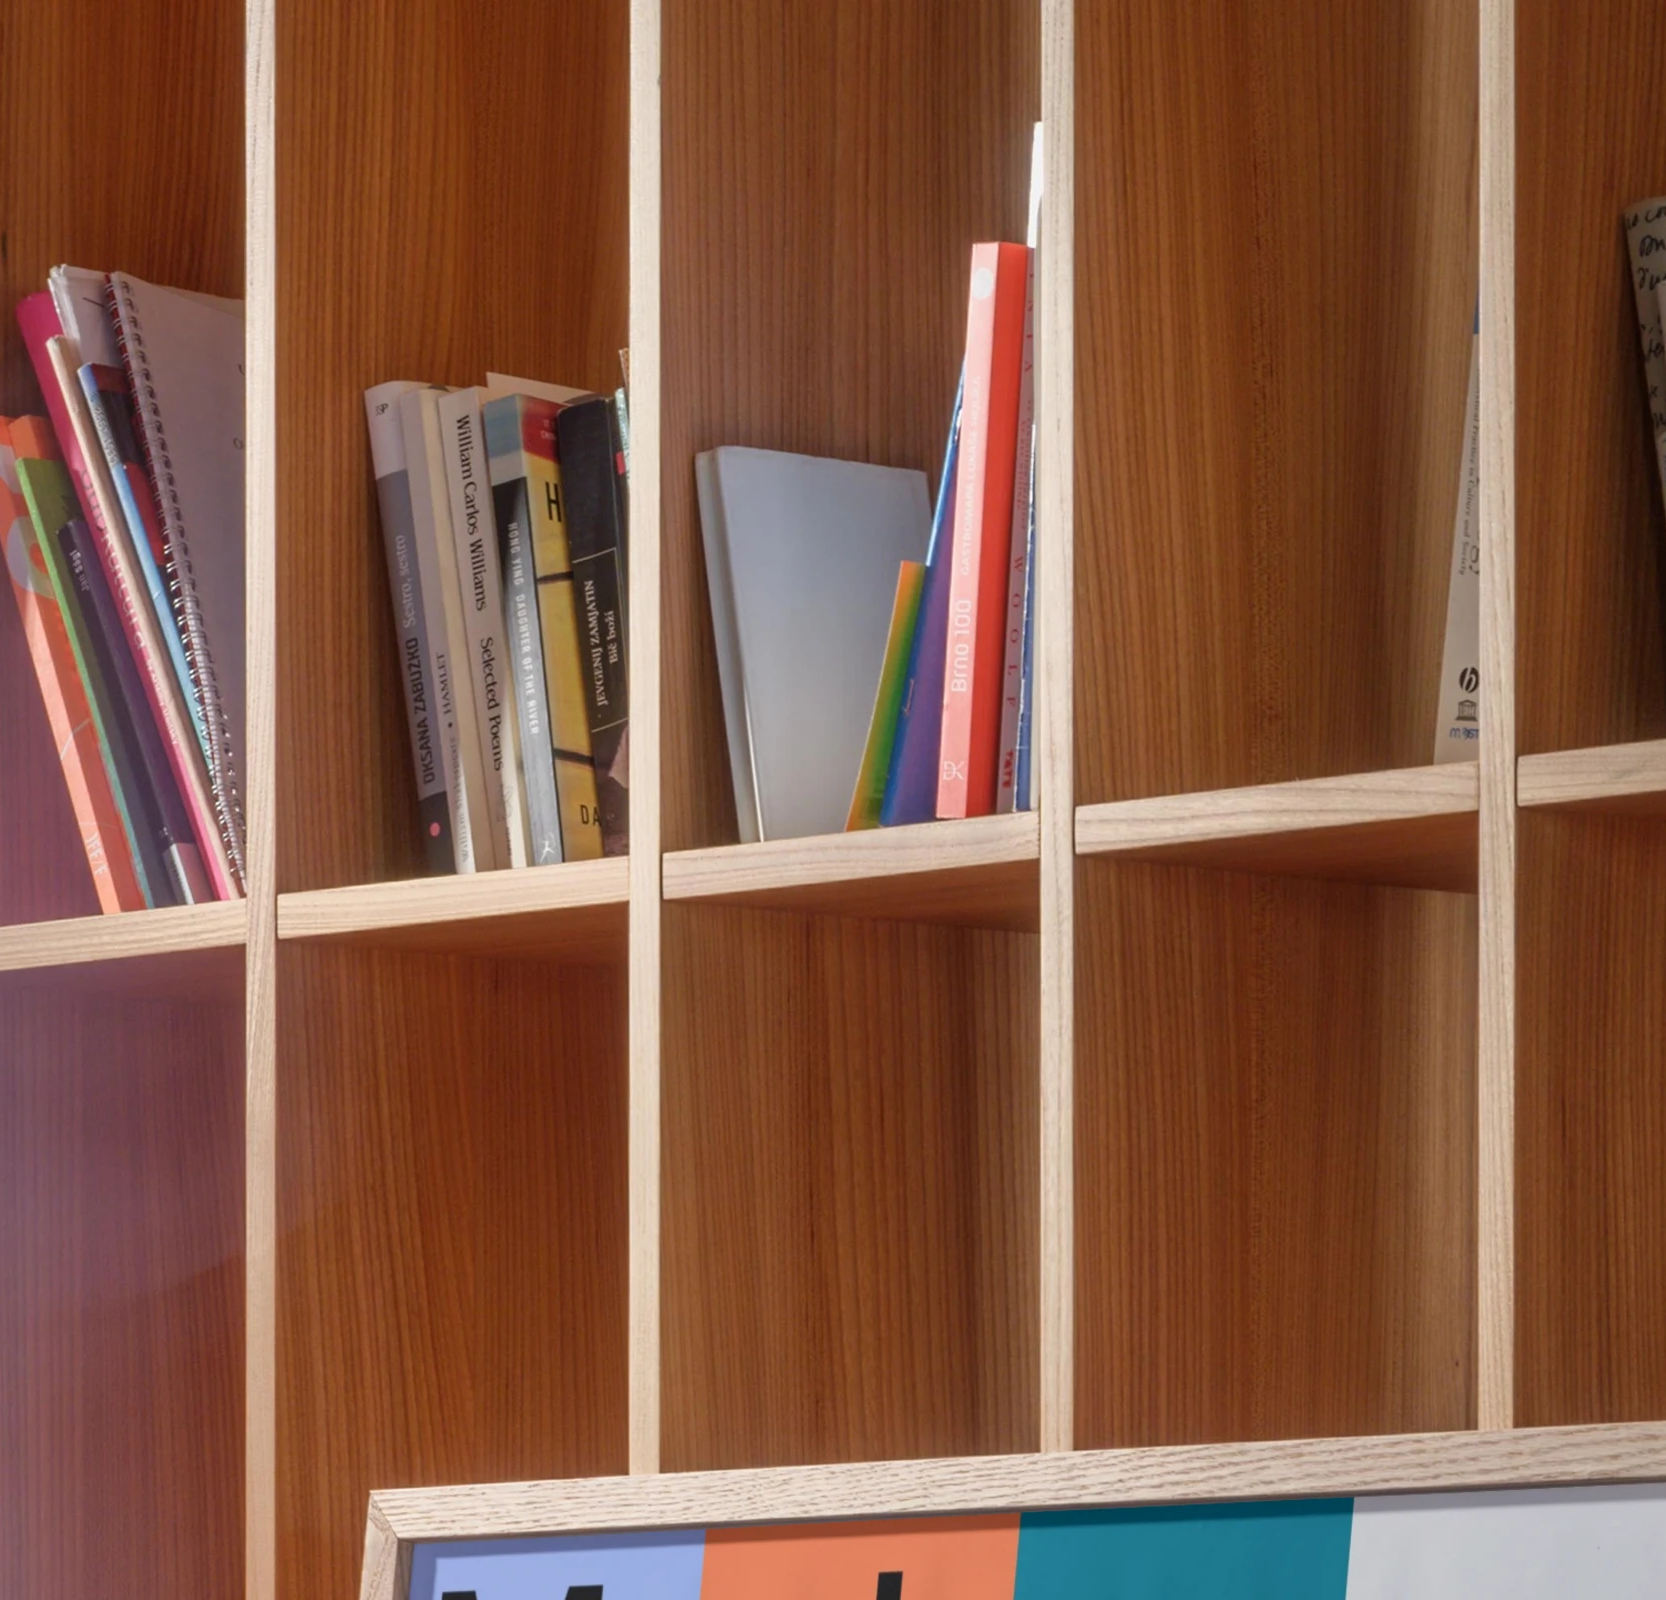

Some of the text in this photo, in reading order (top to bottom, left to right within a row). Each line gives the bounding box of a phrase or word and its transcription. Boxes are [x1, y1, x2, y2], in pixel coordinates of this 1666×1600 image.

[1464, 479, 1476, 516] Culture
[1462, 519, 1472, 537] and
[1457, 541, 1470, 577] Society
[456, 414, 505, 772] William Carlos Williams Selected Poems
[955, 600, 972, 637] 100
[507, 522, 539, 735] HONG YING DAUGHTER OF THE RIVER
[583, 580, 609, 707] JEVGENIJ ZAMJATIN
[604, 610, 619, 665] Bič boží
[394, 535, 436, 785] OKSANA ZABUŽKO Sestro, sestro
[436, 652, 452, 715] HAMLET
[951, 650, 969, 692] Brno
